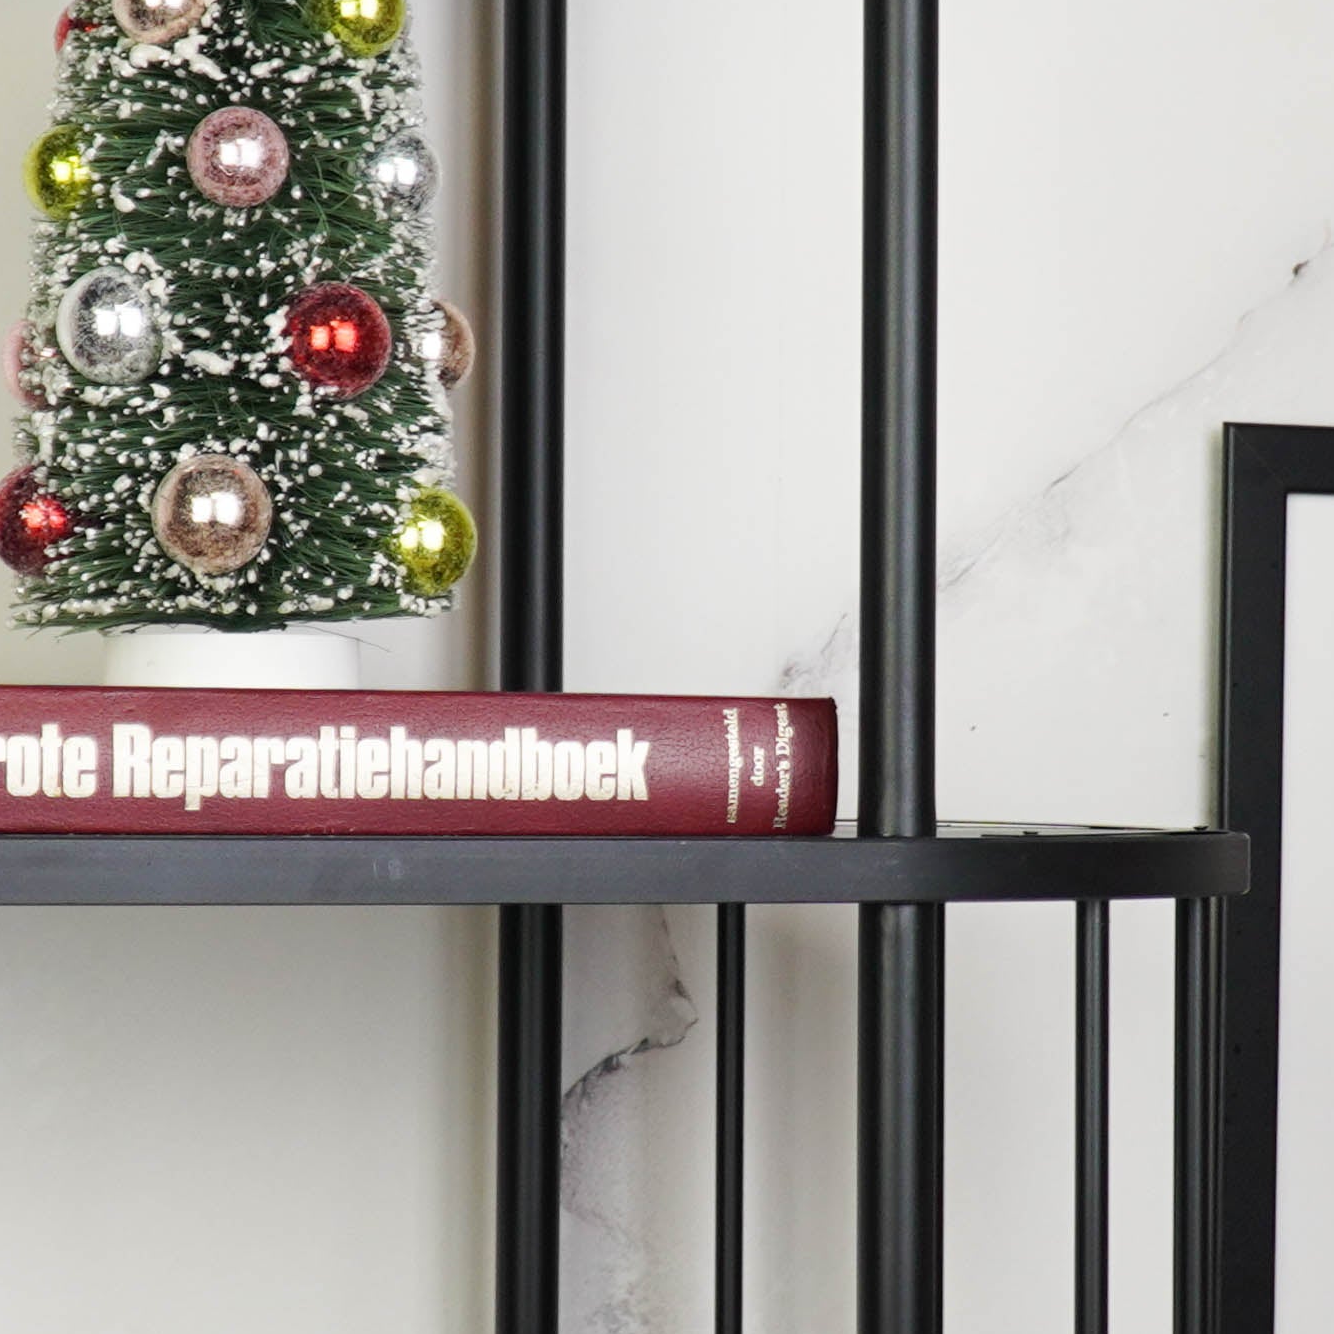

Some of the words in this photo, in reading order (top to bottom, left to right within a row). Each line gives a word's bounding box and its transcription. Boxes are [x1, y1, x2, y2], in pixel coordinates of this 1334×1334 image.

[773, 702, 794, 756] Digest
[112, 723, 650, 812] Reparatiehandboek
[723, 707, 744, 824] samengesteld
[750, 746, 766, 787] door
